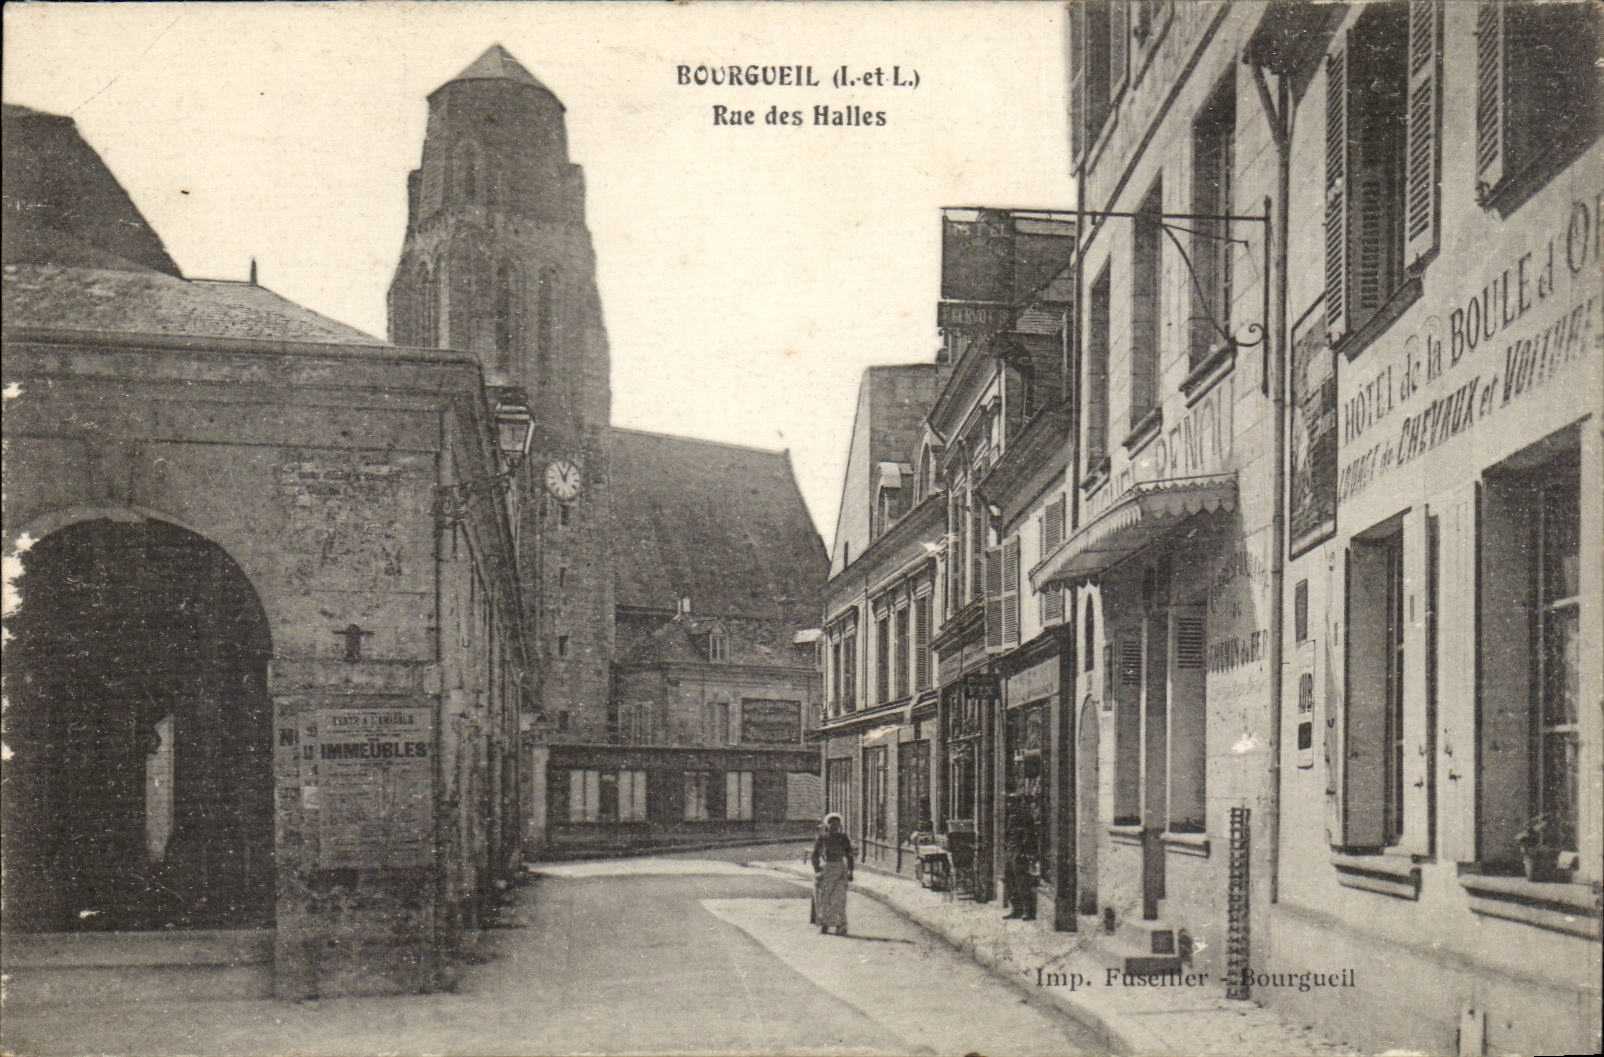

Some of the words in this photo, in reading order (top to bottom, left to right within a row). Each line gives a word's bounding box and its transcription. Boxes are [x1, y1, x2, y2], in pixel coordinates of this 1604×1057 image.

[1400, 352, 1421, 402] de
[1426, 332, 1442, 385] la
[1449, 250, 1532, 370] BOULE
[1396, 374, 1481, 468] CHEVAUX
[1480, 373, 1499, 419] et
[320, 742, 427, 760] IMMEUBLES
